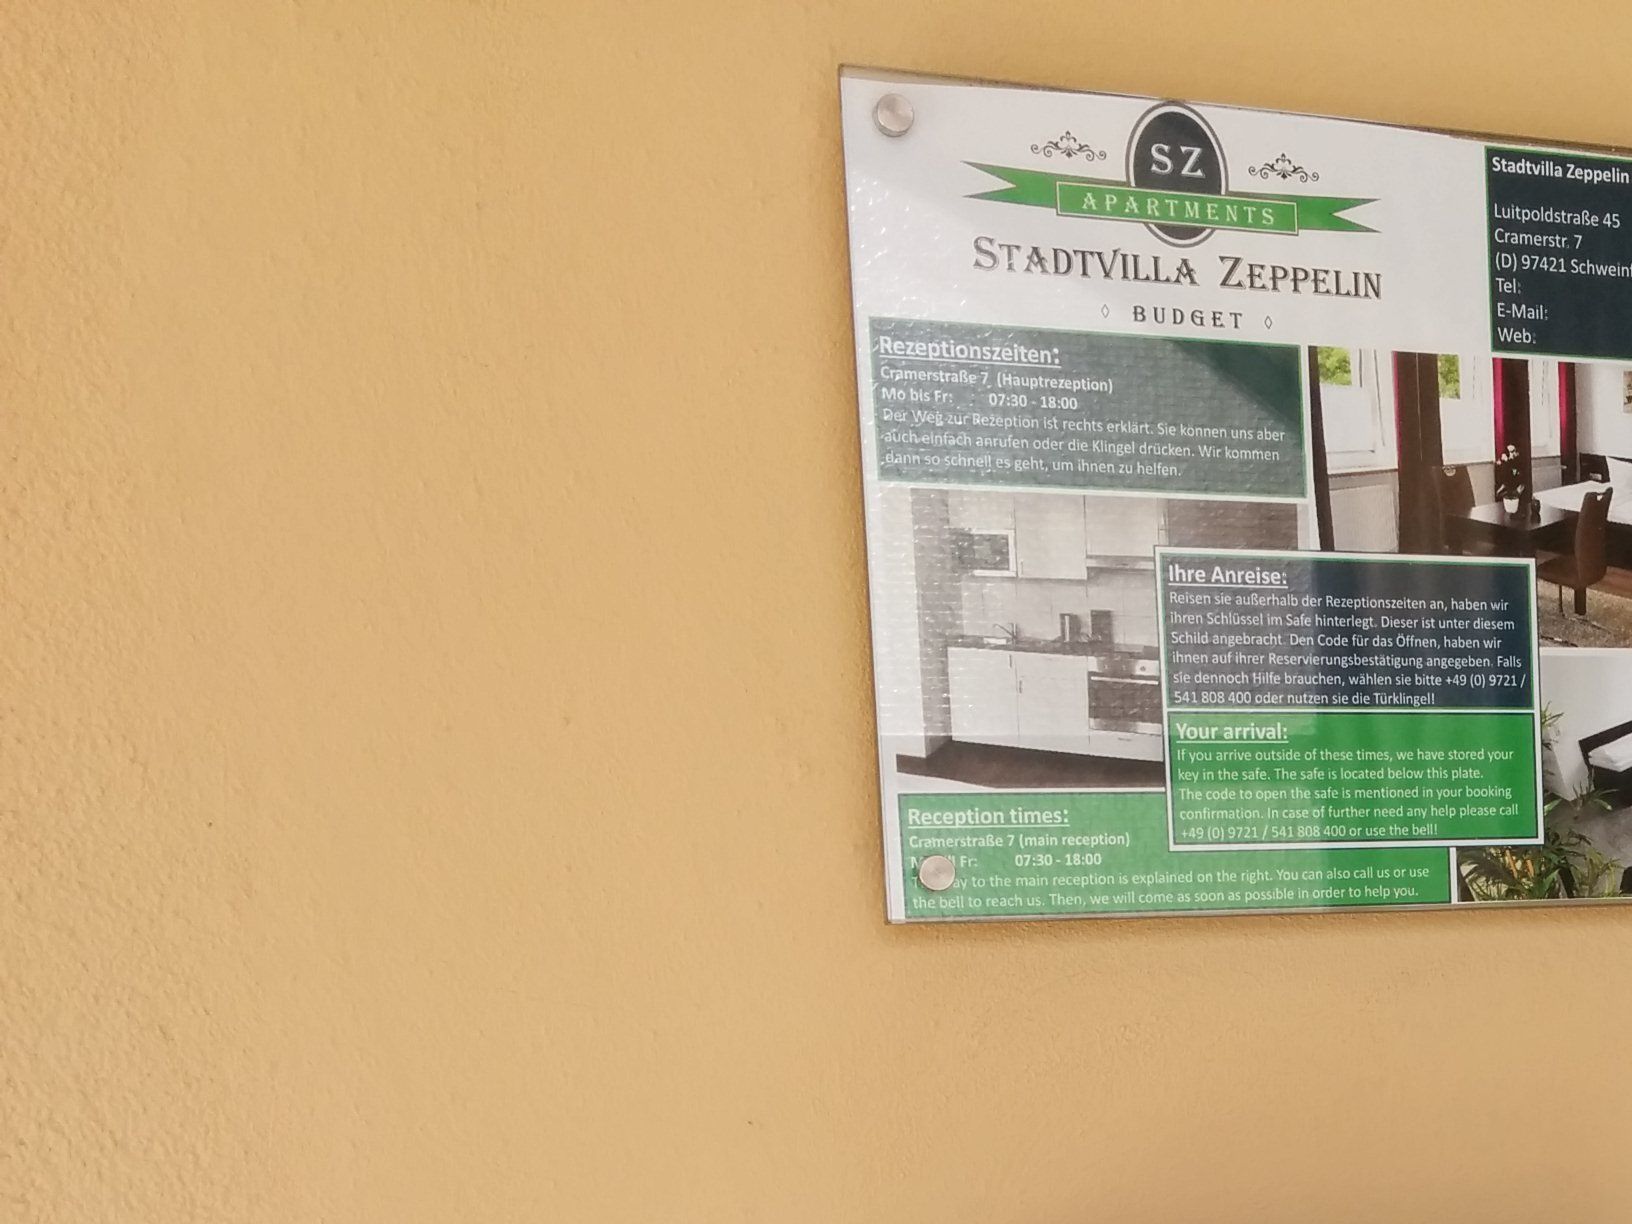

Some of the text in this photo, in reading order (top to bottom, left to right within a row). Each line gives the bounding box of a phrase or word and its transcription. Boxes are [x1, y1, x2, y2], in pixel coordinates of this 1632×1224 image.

[1150, 143, 1205, 178] SZ
[1491, 156, 1563, 178] Stadtvilla
[1565, 163, 1630, 185] Zeppelin
[1082, 192, 1275, 226] APARTMENTS
[1494, 203, 1621, 228] Luitpoldstraße 45
[1494, 227, 1582, 250] Cramerstr. 7
[972, 236, 1382, 299] STADTVILLA ZEPPELIN
[1495, 251, 1518, 273] (D)
[1520, 255, 1567, 273] 97421
[1495, 278, 1522, 295] Tel:
[1132, 305, 1243, 329] BUDGET
[1497, 303, 1549, 321] E-Mail:
[1497, 327, 1537, 345] Web:
[880, 366, 1114, 394] Cramerstraße 7 (Hauptrezeption)
[881, 386, 907, 401] Mo
[908, 387, 932, 402] bis
[988, 392, 1028, 408] 07:30
[1039, 395, 1078, 410] 18:00
[1168, 565, 1207, 583] Ihre
[1169, 591, 1212, 606] Reisen
[1213, 592, 1232, 606] sie
[1234, 592, 1299, 608] außerhalb
[1300, 593, 1323, 608] der
[1324, 595, 1427, 612] Rezeptionszeiten
[1450, 596, 1488, 611] haben
[1488, 597, 1509, 612] wir
[1176, 723, 1219, 740] Your
[1177, 747, 1187, 761] If
[1187, 750, 1213, 764] you
[1214, 747, 1253, 761] arrive
[1253, 747, 1302, 761] outside
[1302, 747, 1318, 761] of
[1318, 747, 1354, 761] these
[1394, 750, 1415, 761] we
[1415, 746, 1445, 761] have
[1446, 746, 1486, 761] stored
[1485, 750, 1514, 764] your
[908, 806, 1005, 829] Reception
[909, 830, 1130, 849] Cramerstraße 7 (main reception)
[1015, 852, 1054, 867] 07:30
[1063, 852, 1102, 866] 18:00
